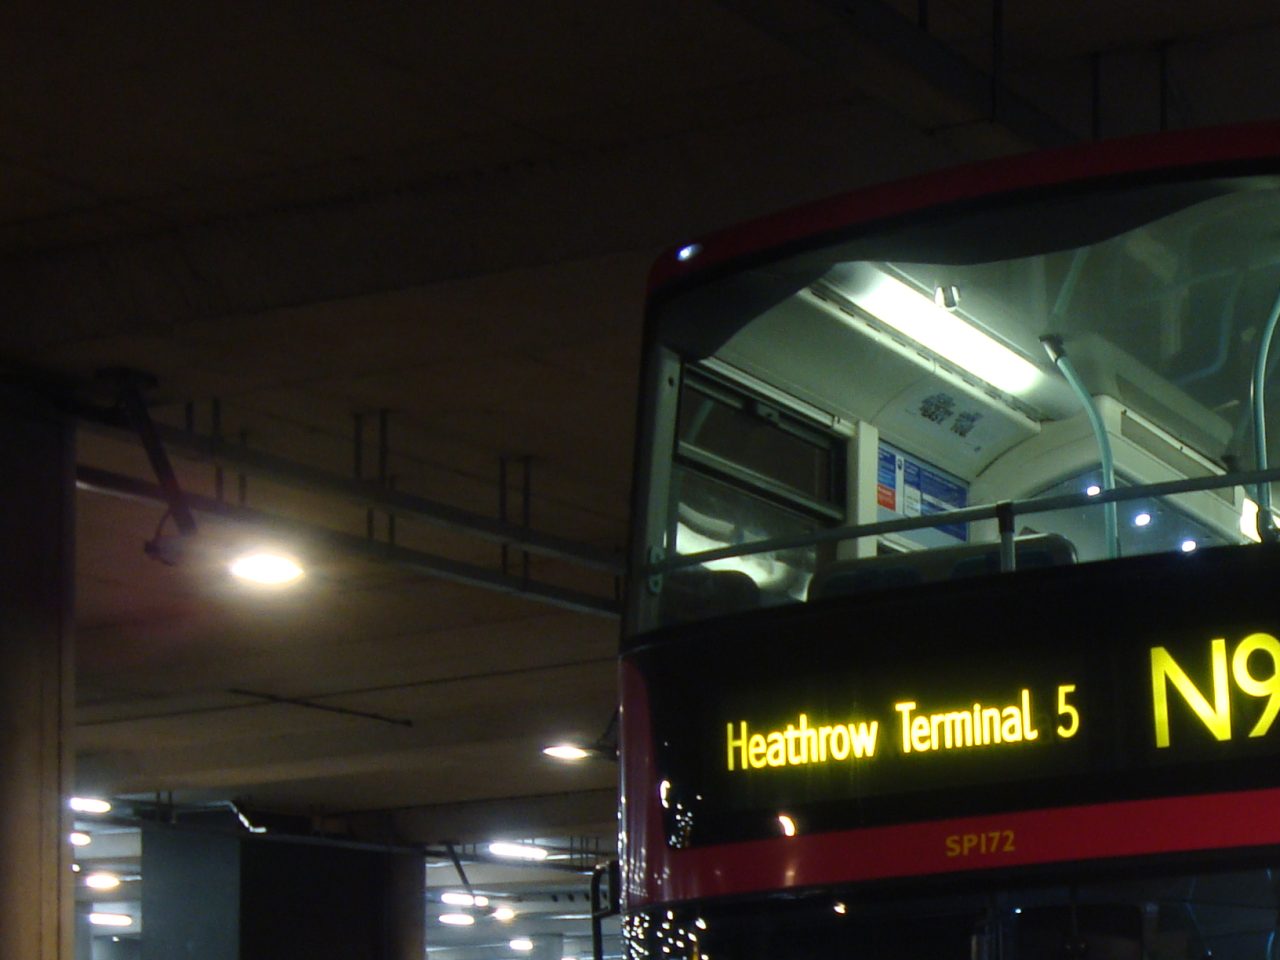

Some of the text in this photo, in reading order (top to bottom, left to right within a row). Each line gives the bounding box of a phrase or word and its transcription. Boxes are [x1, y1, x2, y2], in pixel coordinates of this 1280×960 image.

[726, 684, 1080, 772] Heathrow Terminal 5
[944, 830, 1017, 858] SP172
